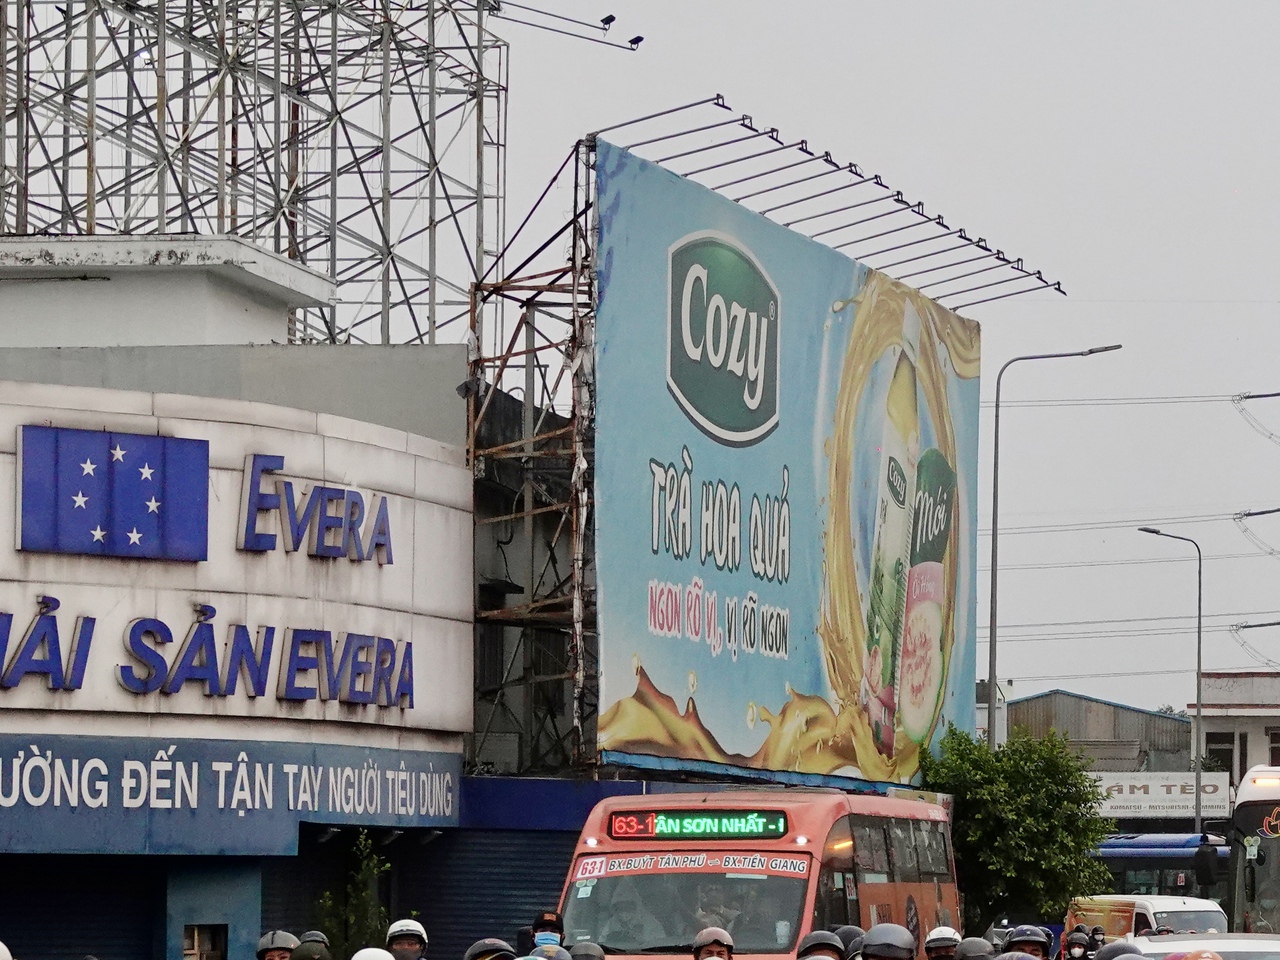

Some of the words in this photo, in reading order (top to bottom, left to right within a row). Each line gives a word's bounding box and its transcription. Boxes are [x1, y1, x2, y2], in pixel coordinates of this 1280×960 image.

[681, 263, 768, 410] Cozy
[238, 454, 394, 565] EVERA
[649, 444, 693, 560] TRÀ
[700, 478, 741, 573] HOA
[889, 461, 906, 502] Cozy
[916, 486, 947, 553] Mới
[0, 595, 97, 690] ẢI
[115, 604, 275, 697] SẢN
[277, 628, 415, 709] EVERA
[650, 585, 681, 634] NGON
[687, 581, 702, 637] RÕ
[727, 602, 737, 657] VỊ
[743, 596, 757, 649] RÕ
[761, 610, 788, 655] NGON
[121, 745, 199, 809] ĐẾN
[212, 752, 273, 817] TẬN
[283, 763, 323, 812] TAY
[328, 758, 381, 815] NGƯỜI
[386, 761, 415, 816] TIÊU
[419, 762, 453, 816] DÙNG
[615, 815, 653, 834] 63-1
[682, 816, 718, 833] SƠN
[722, 813, 766, 833] NHẤT
[658, 854, 681, 868] TÂN
[769, 859, 807, 873] GIANG
